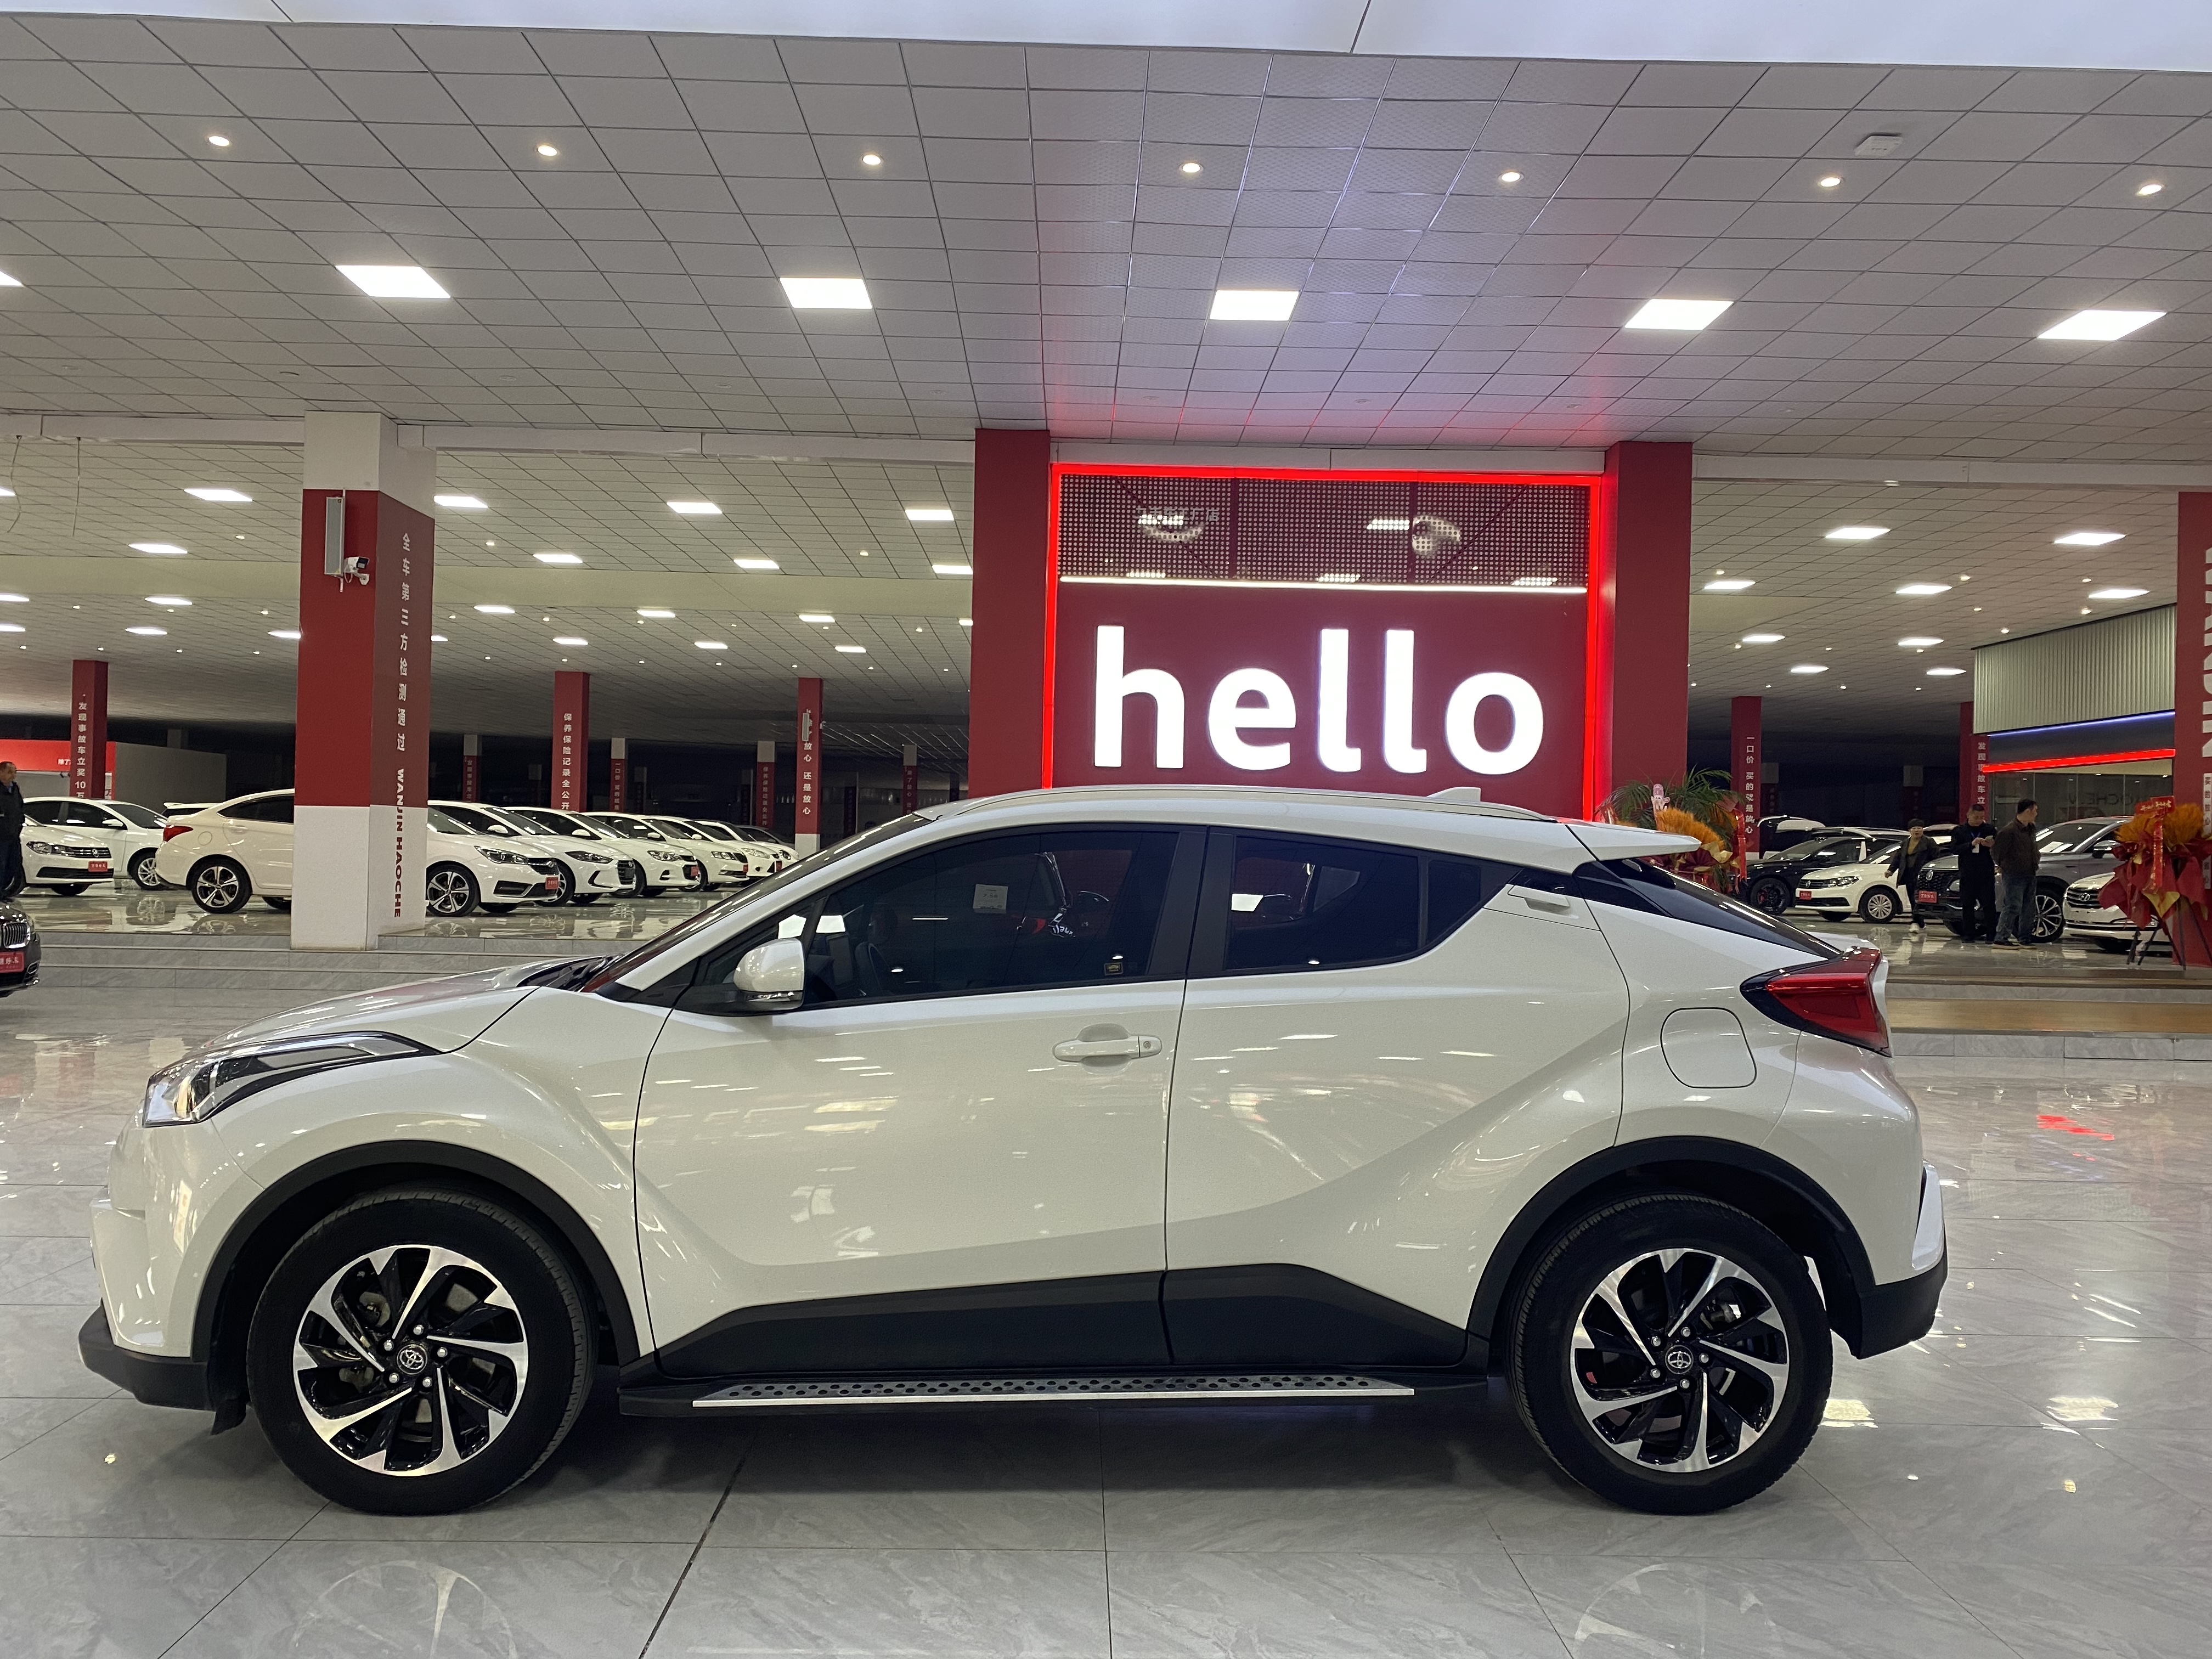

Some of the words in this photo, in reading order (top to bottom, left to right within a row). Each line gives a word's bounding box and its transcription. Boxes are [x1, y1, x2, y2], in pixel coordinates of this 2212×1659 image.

[397, 533, 410, 752] 全车第三方检测通过
[1094, 625, 1544, 775] hello
[561, 713, 572, 810] 保养保险记录全公开
[1746, 737, 1755, 764] 一口价
[396, 769, 404, 832] WANJIN
[803, 772, 811, 815] 还是放心
[394, 837, 403, 918] HAOCHE
